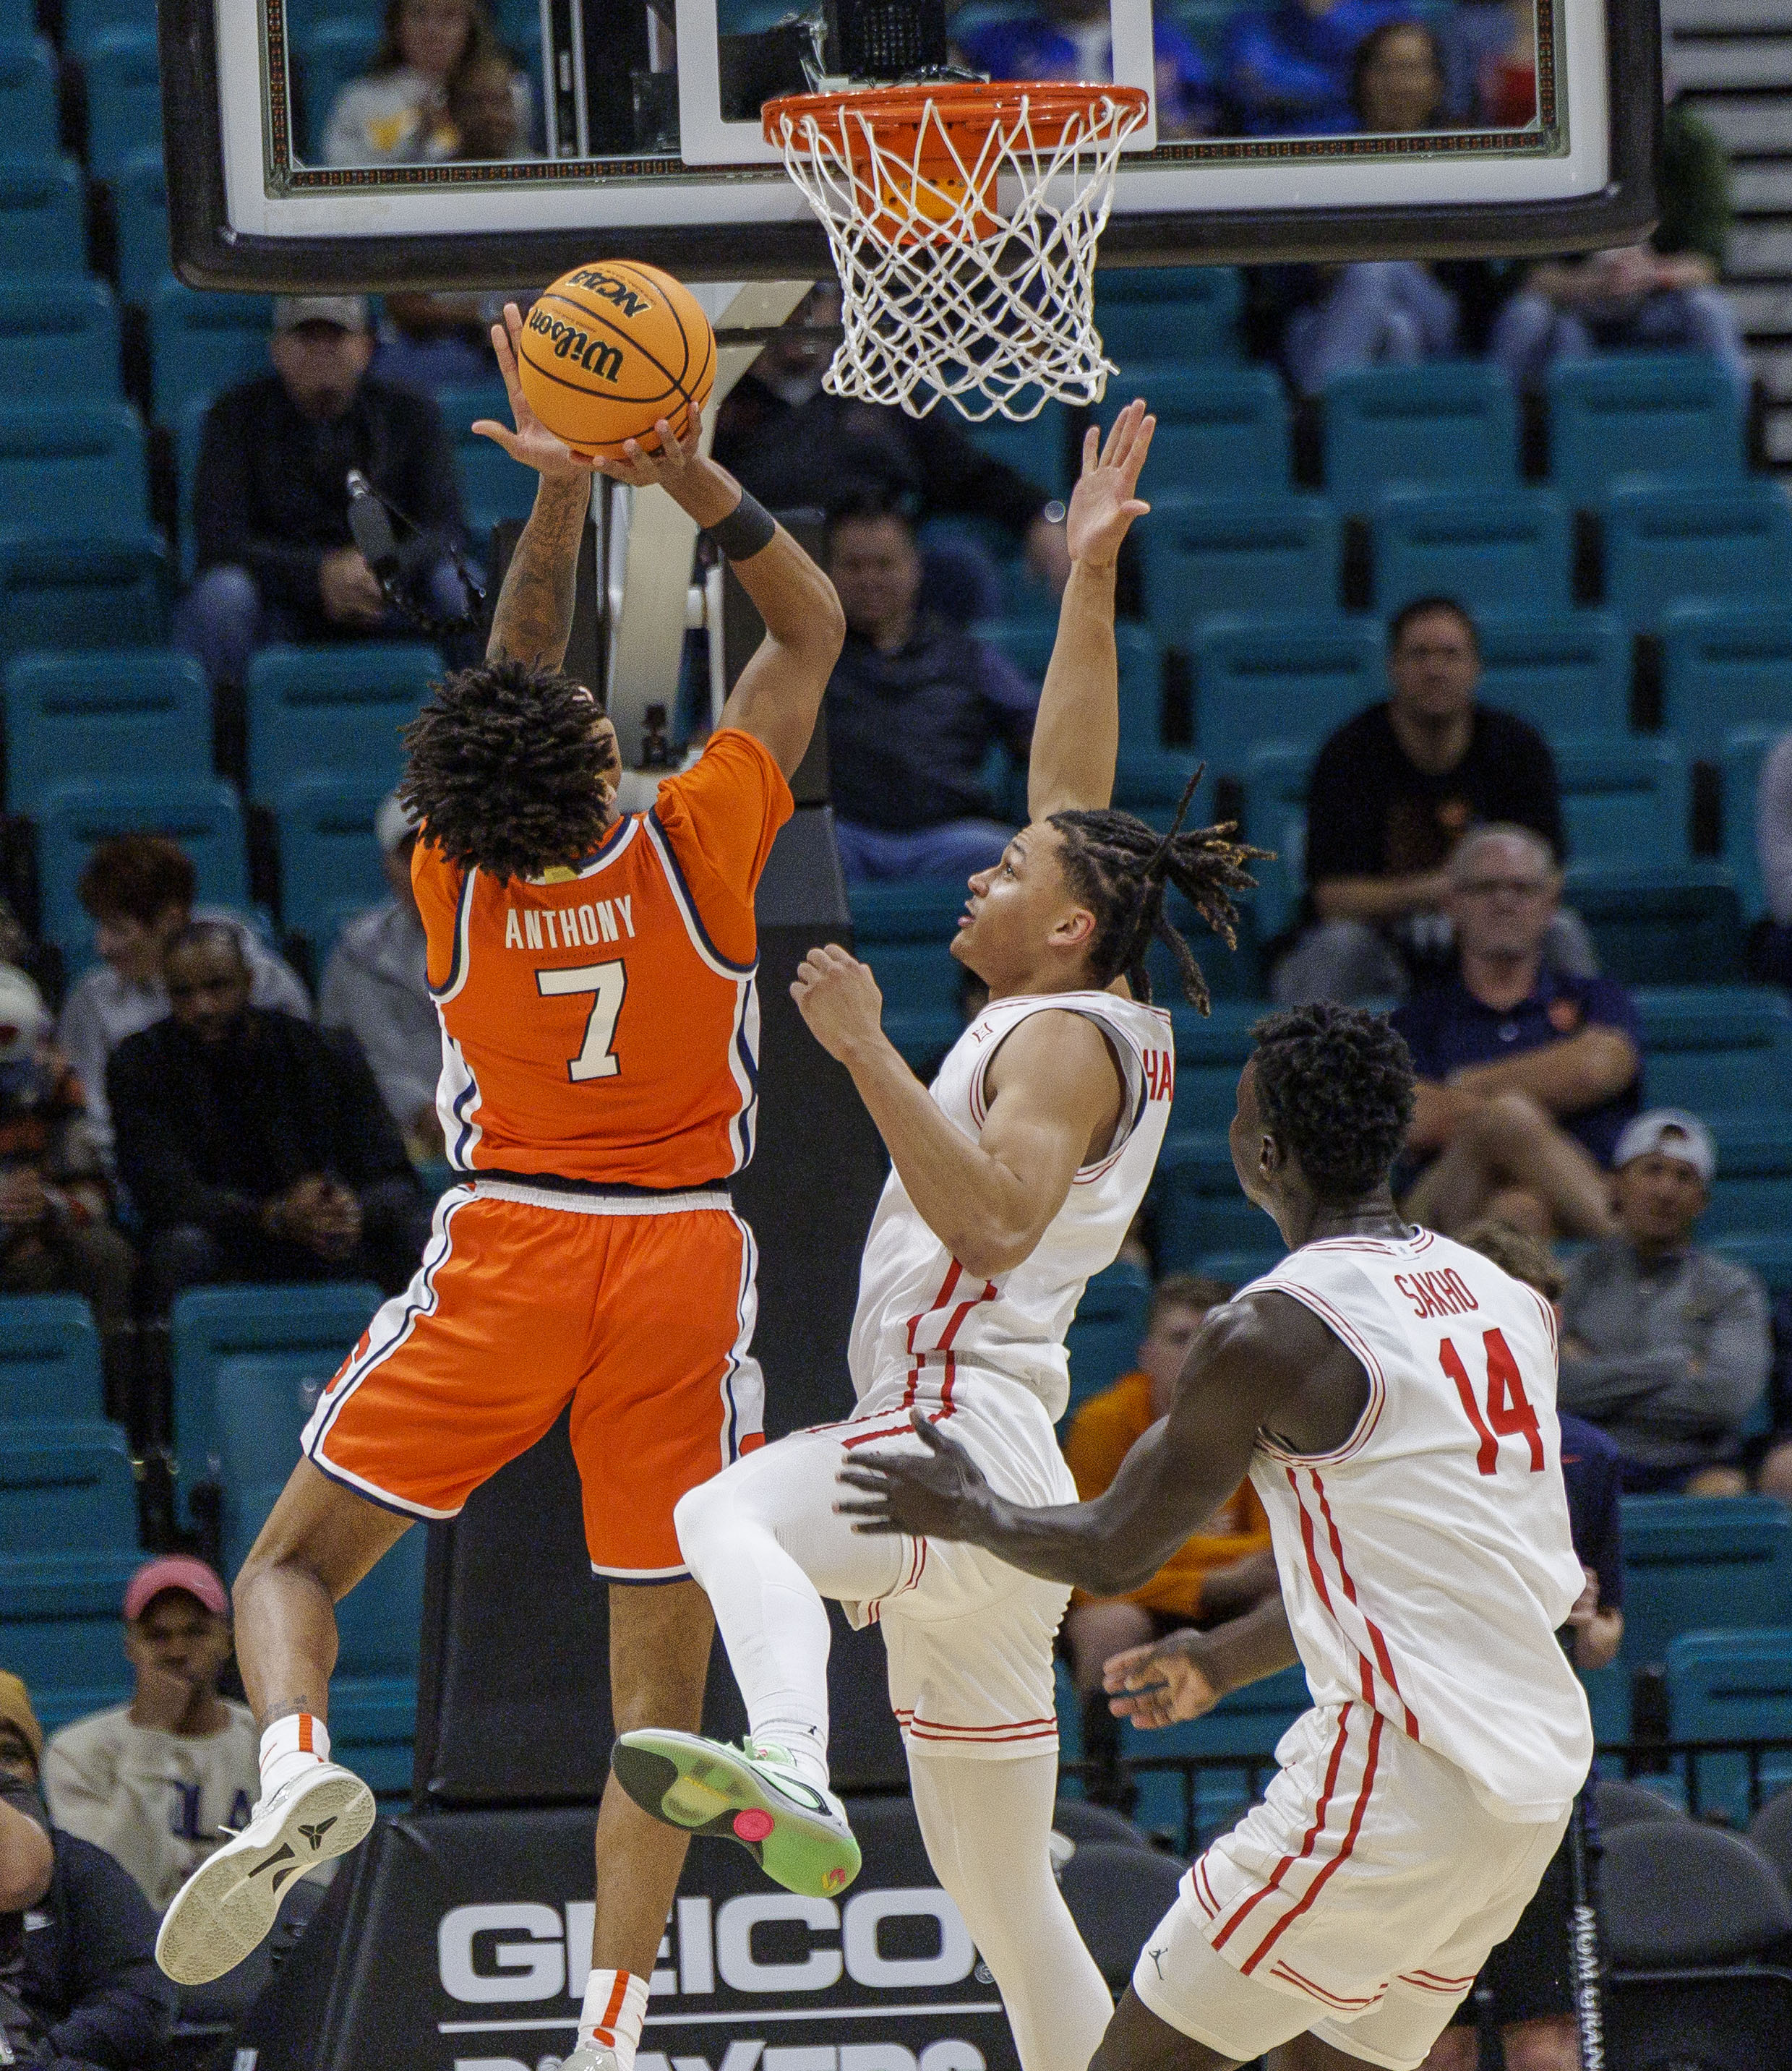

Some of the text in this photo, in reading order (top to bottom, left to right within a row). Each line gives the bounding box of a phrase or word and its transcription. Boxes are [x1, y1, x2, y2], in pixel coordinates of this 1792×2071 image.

[565, 270, 652, 318] NCAA
[529, 308, 624, 384] Wilson
[505, 894, 635, 950] ANTHONY
[534, 957, 628, 1084] 7
[1394, 1267, 1479, 1319] SAKHO
[1439, 1327, 1546, 1476] 14
